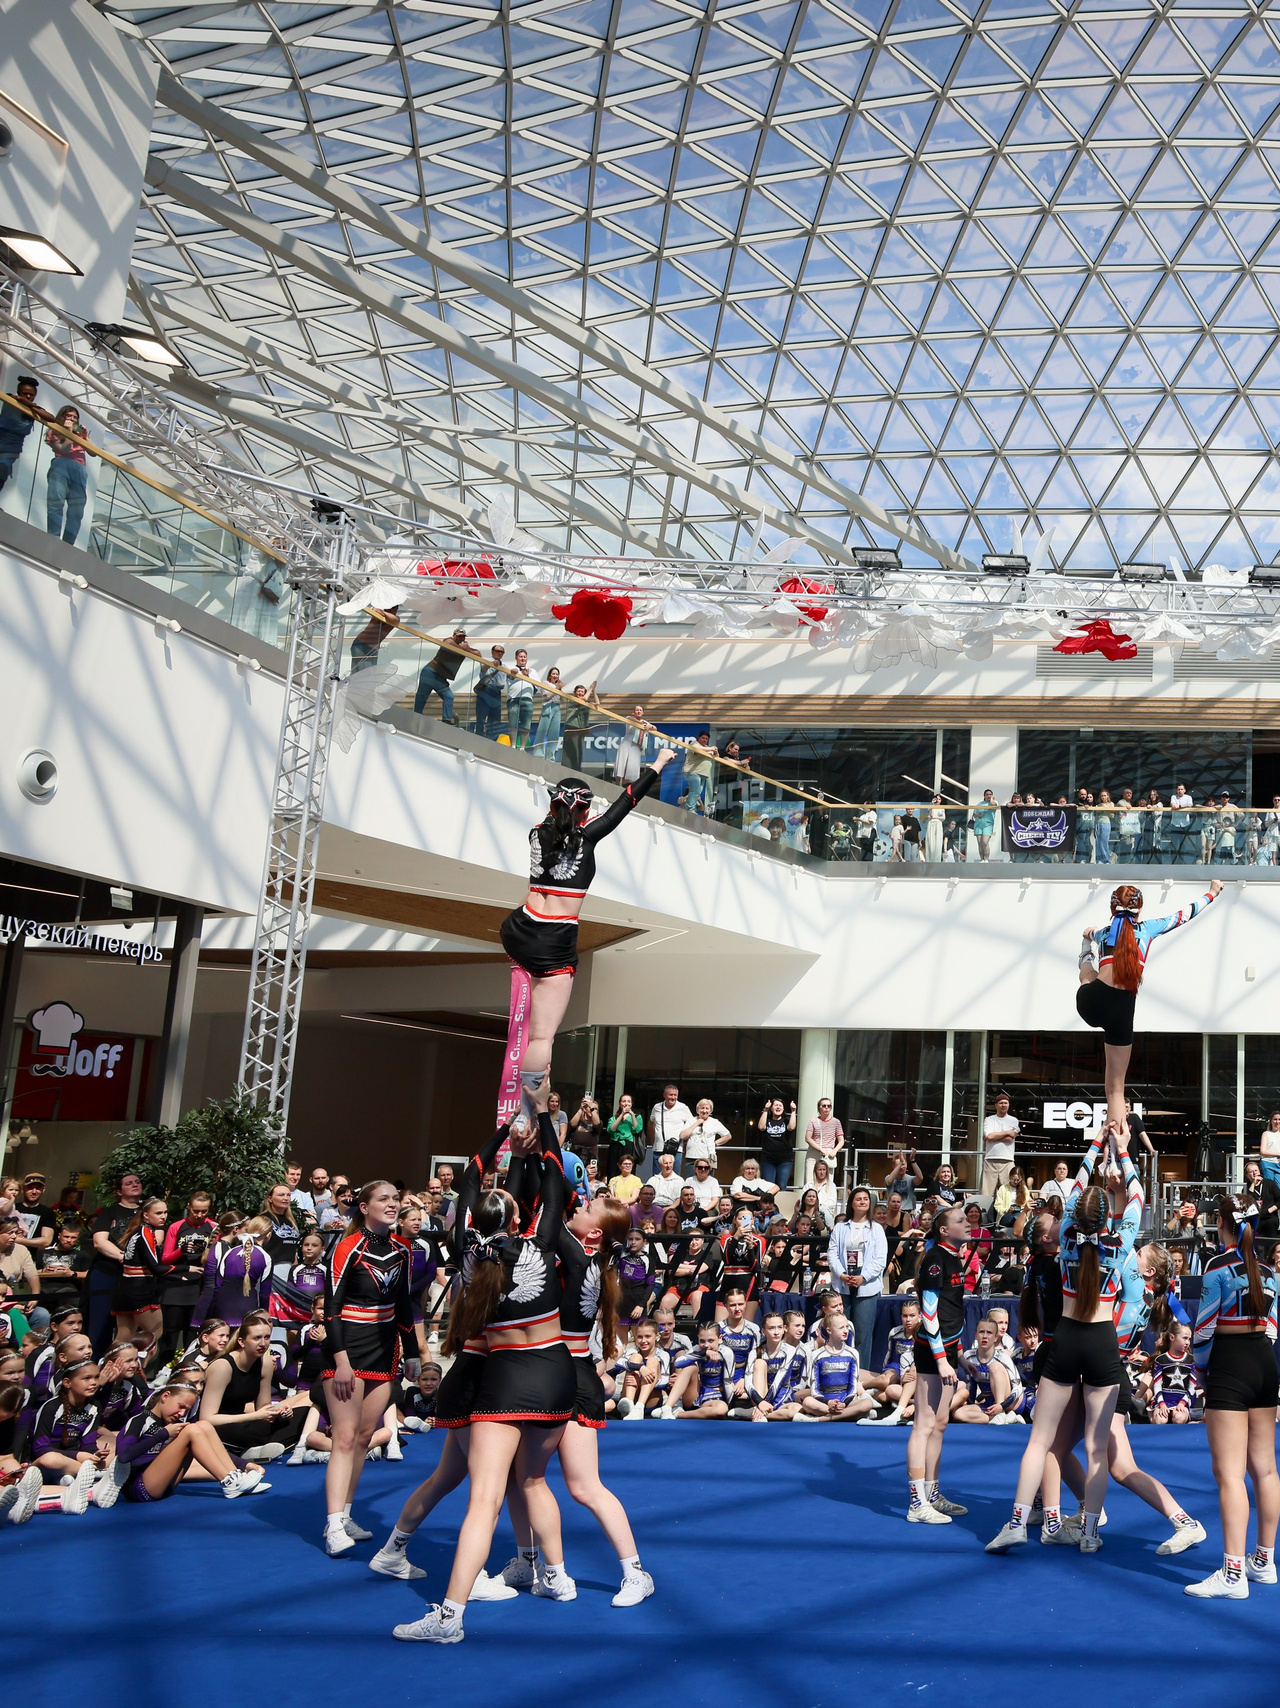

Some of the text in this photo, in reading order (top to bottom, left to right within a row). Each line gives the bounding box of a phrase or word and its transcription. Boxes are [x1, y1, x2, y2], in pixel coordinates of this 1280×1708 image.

[1017, 831, 1061, 841] CHEER FLY
[94, 934, 164, 965] пекарь
[514, 983, 528, 1022] School
[509, 1025, 524, 1062] Cheer
[505, 1064, 519, 1093] Ural
